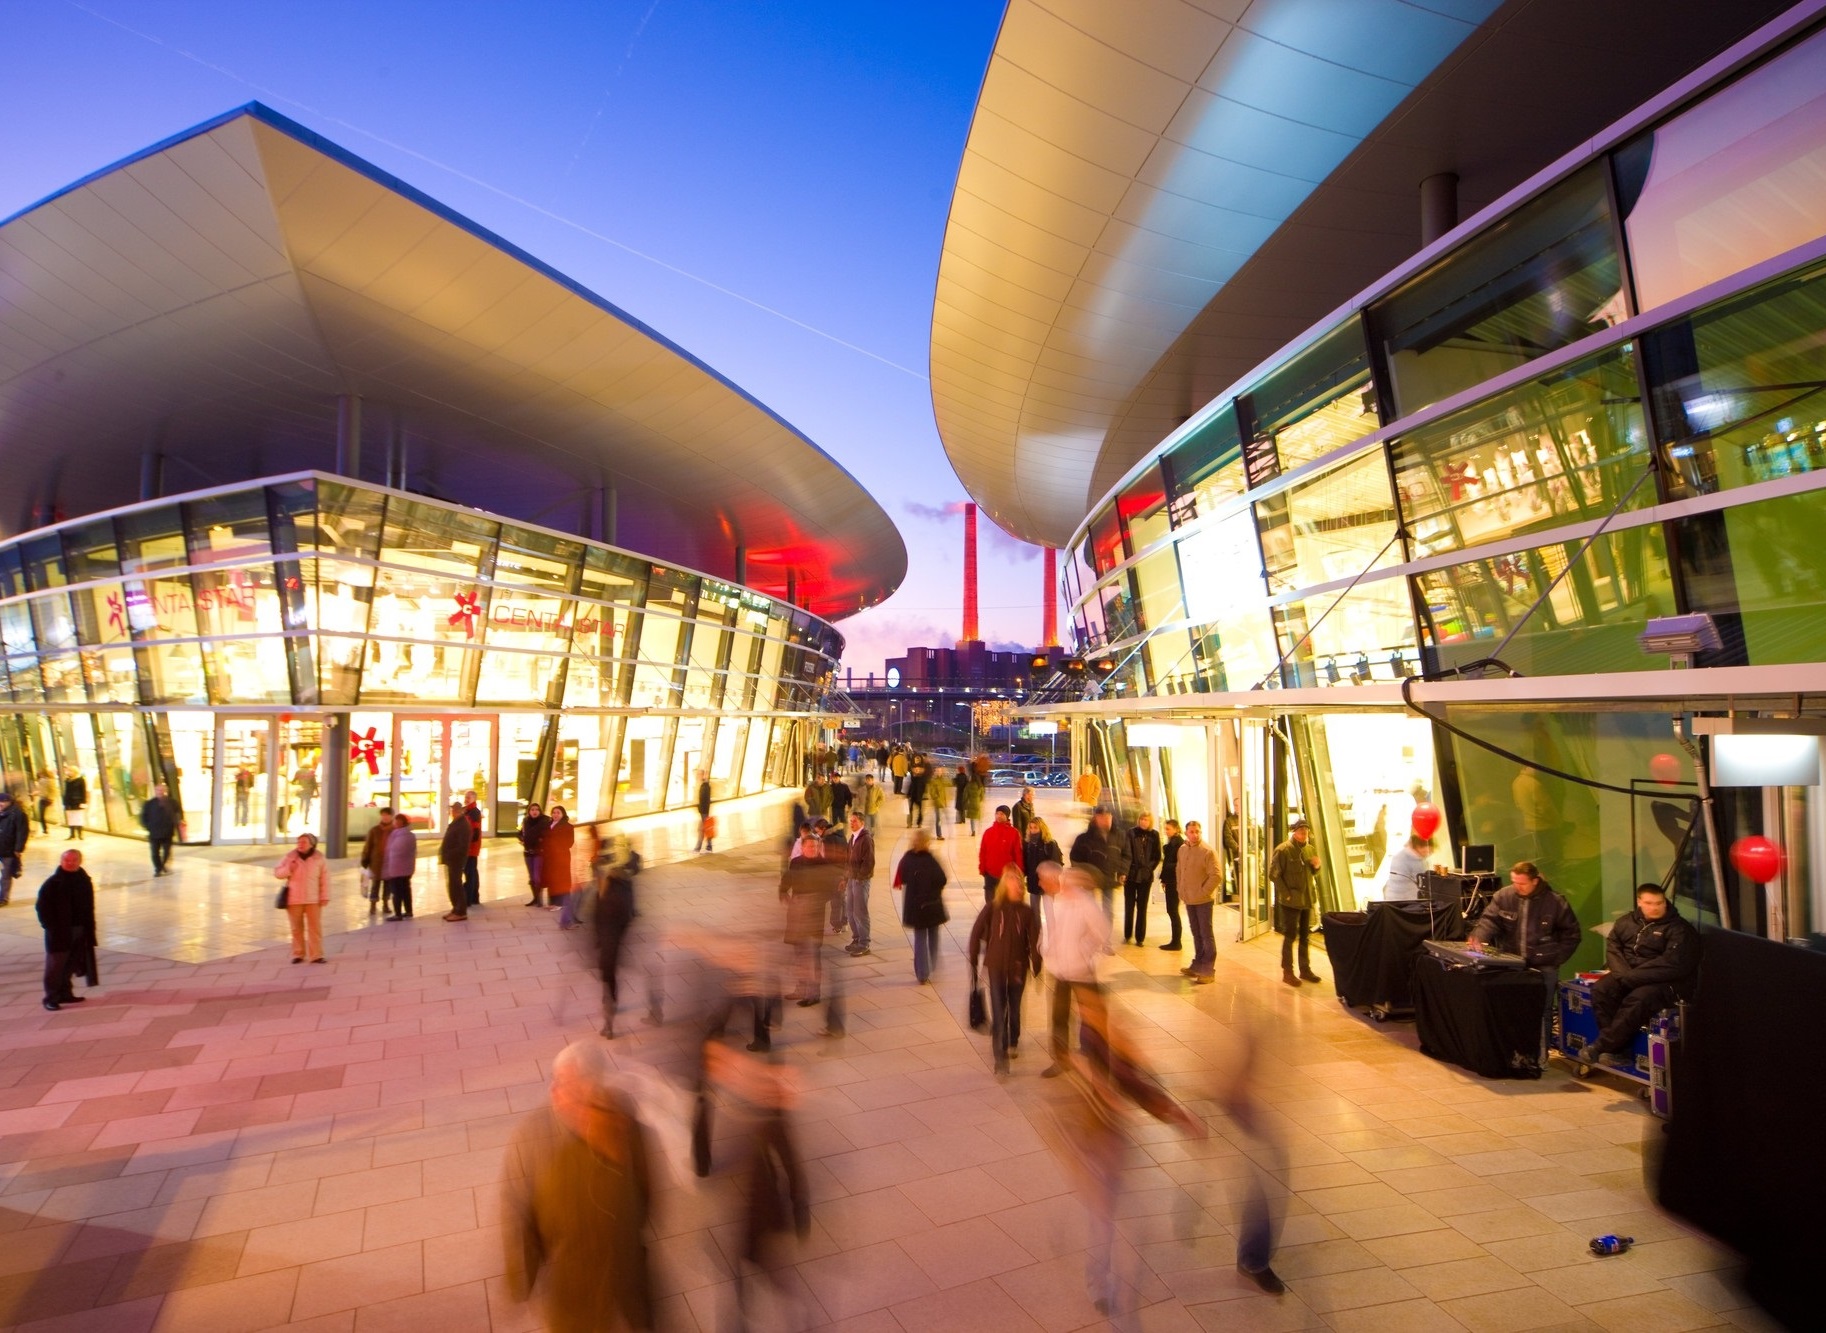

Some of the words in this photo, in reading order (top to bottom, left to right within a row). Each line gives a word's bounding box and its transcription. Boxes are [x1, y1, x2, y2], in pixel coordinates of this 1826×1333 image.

[153, 592, 193, 615] NTA
[493, 604, 571, 631] CENTA
[576, 616, 625, 639] STAR
